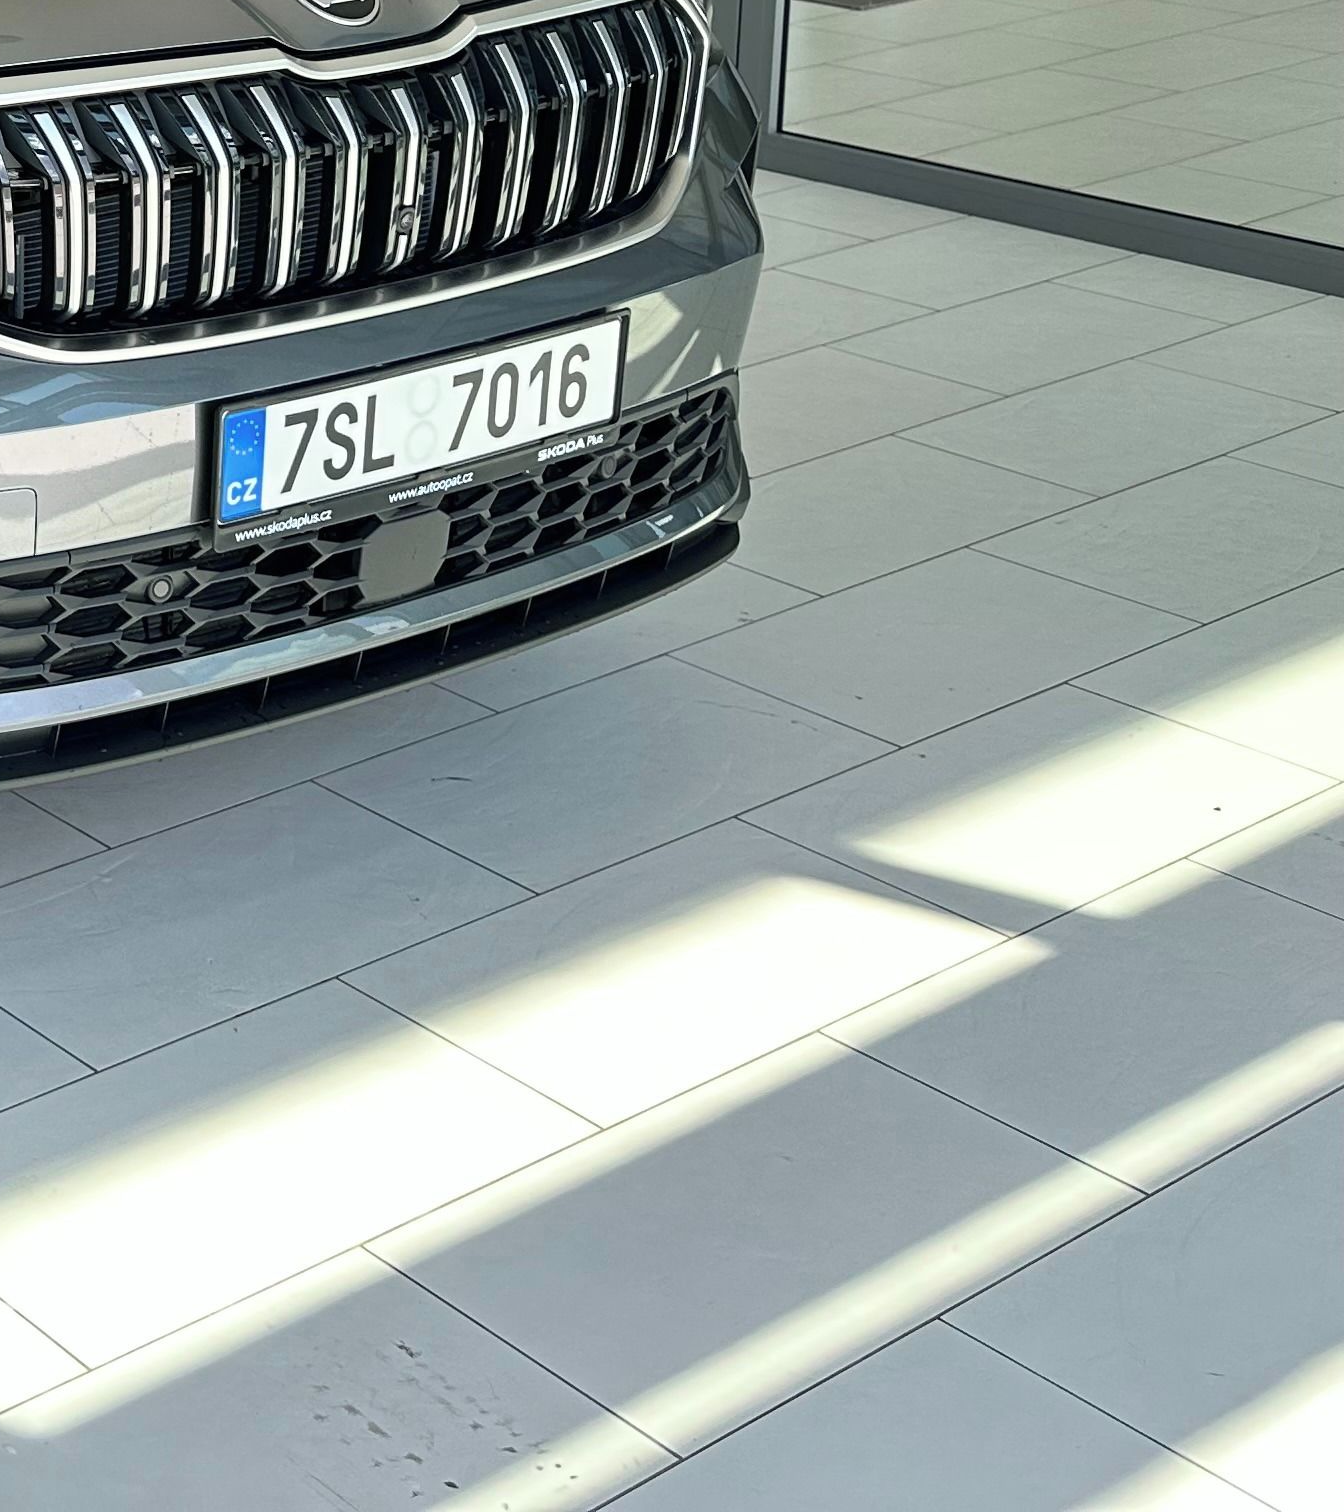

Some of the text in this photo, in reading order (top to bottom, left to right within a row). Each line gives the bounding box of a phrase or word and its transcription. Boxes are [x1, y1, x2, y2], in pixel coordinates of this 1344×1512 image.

[280, 342, 591, 494] 7SL 7016
[226, 476, 258, 506] CZ
[388, 471, 475, 504] www.autoopat.cz
[234, 508, 334, 543] www.skodaplus.cz
